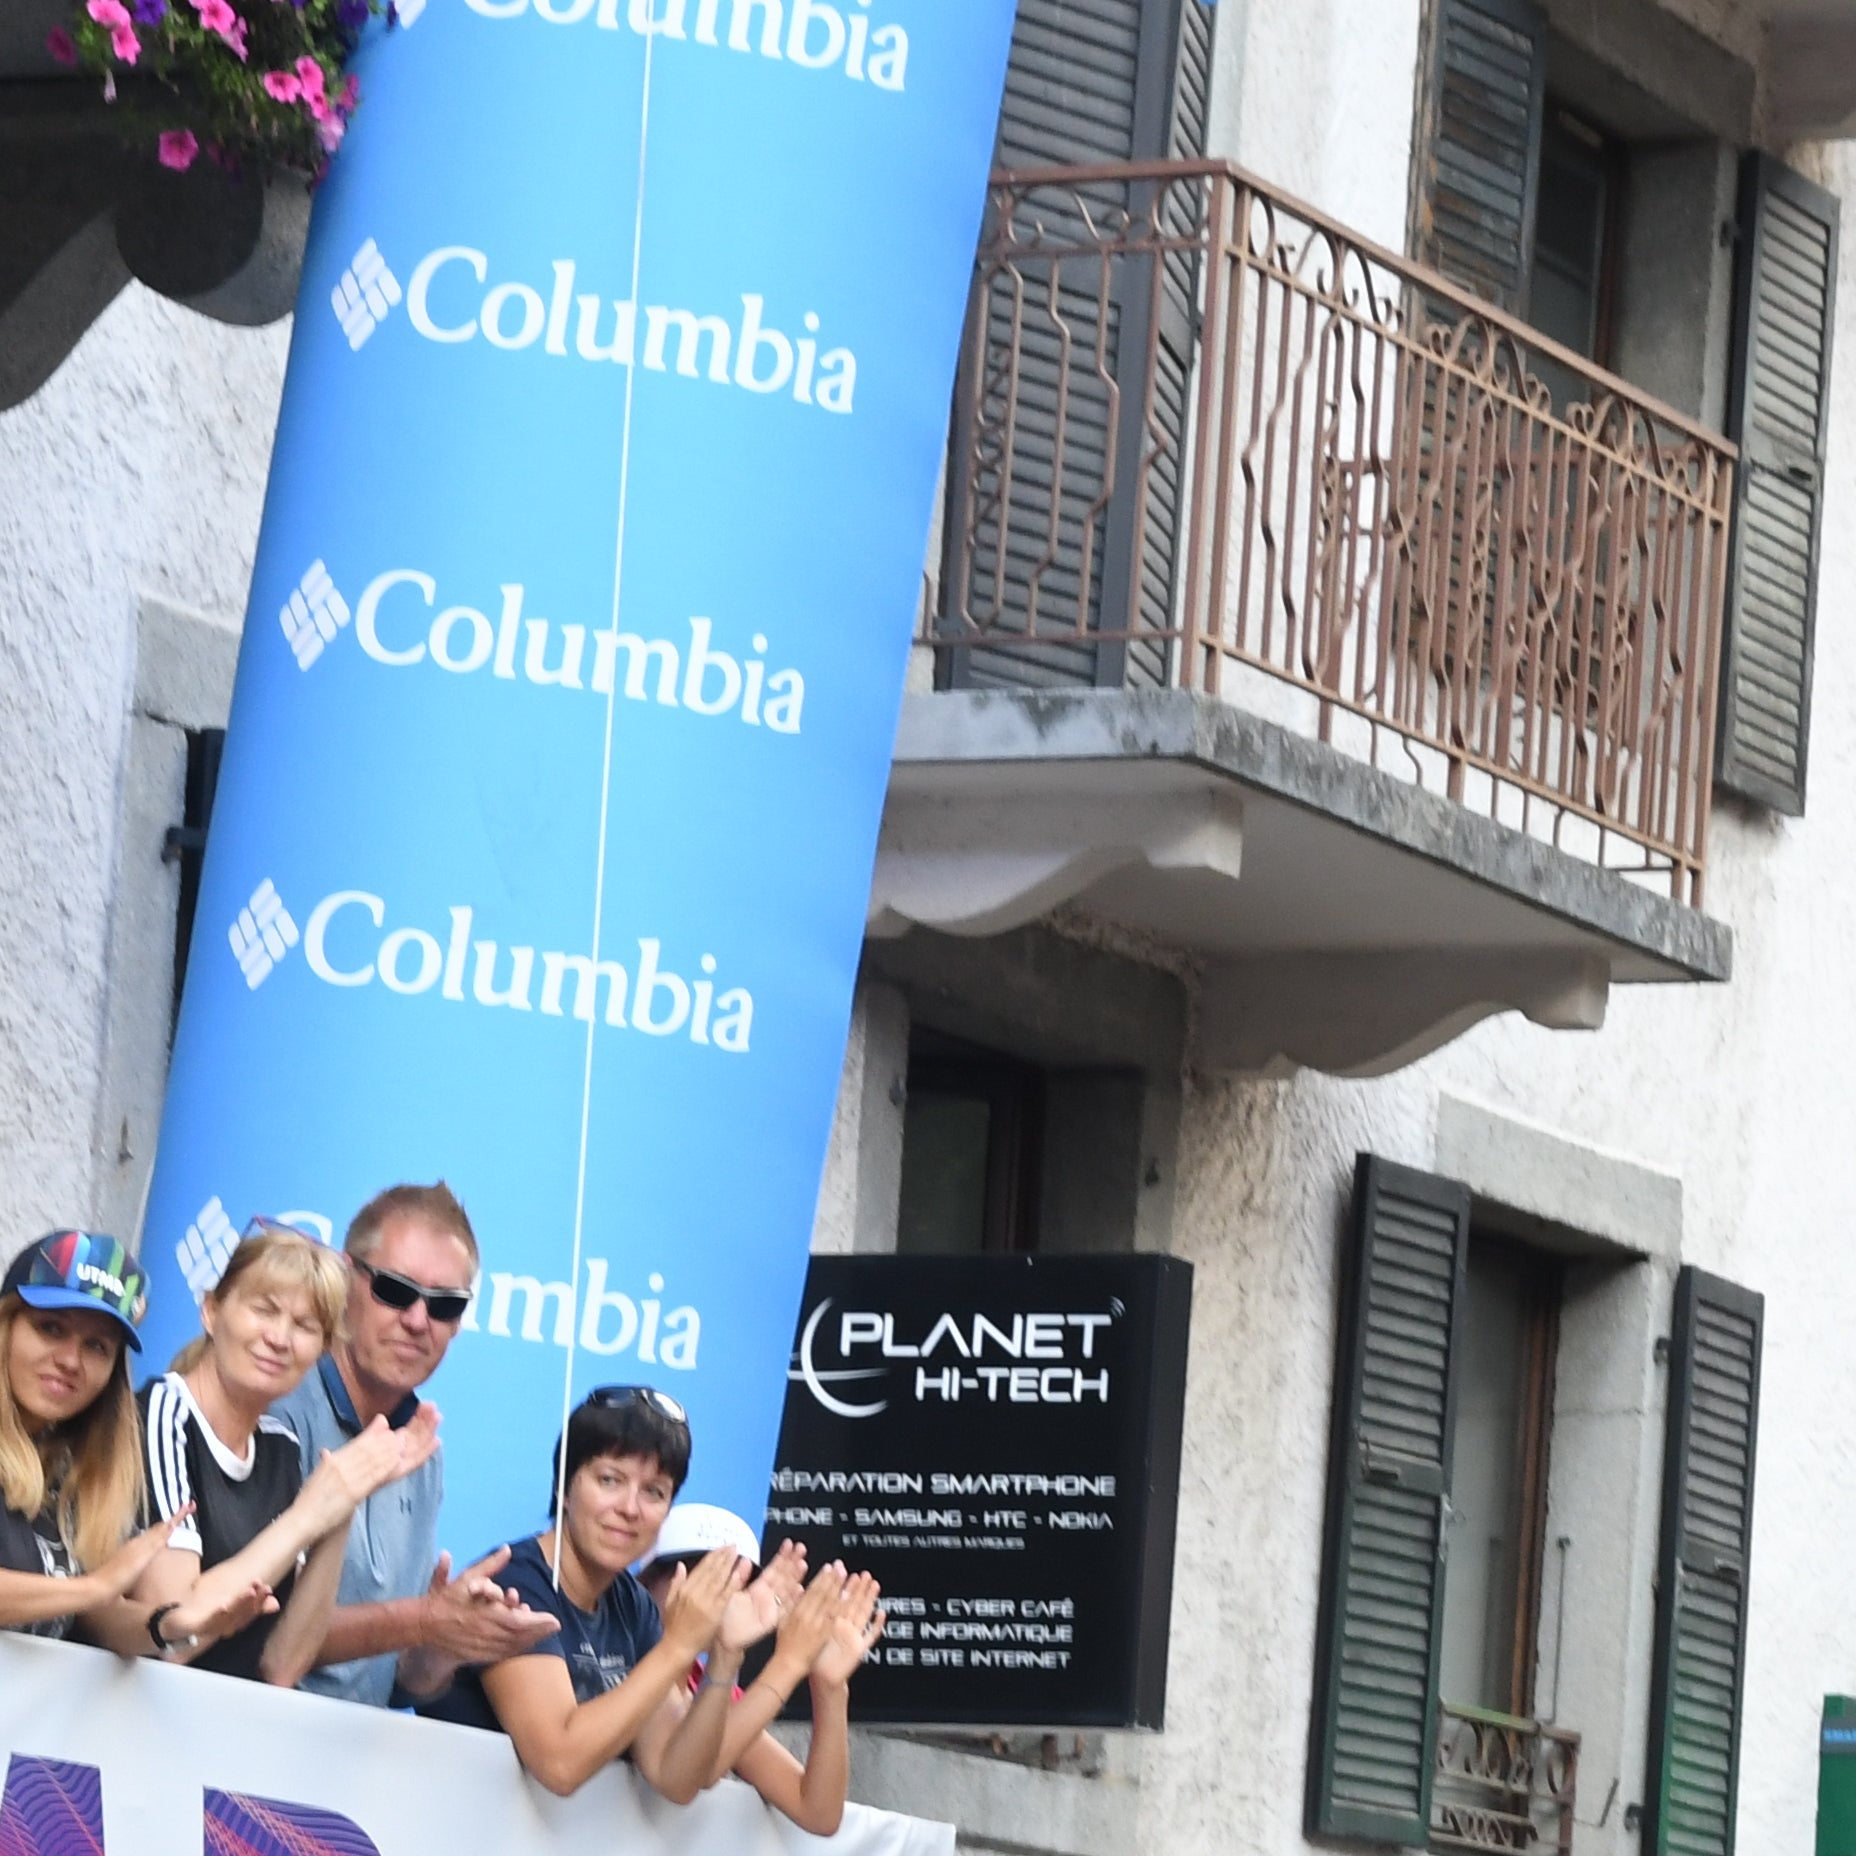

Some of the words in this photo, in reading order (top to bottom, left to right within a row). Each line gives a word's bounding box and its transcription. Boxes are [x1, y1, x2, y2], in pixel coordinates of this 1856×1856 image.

[406, 245, 857, 413] Columbia
[355, 569, 805, 735] Columbia
[304, 889, 755, 1052] Columbia
[840, 1312, 1112, 1359] PLANET
[914, 1366, 1110, 1403] HI-TECH
[930, 1472, 1117, 1498] SMARTPHONE
[854, 1508, 963, 1529] SAMSUNG
[983, 1509, 1028, 1530] HTC
[1048, 1511, 1114, 1531] NOKIA
[946, 1598, 1016, 1618] CYBER
[1020, 1595, 1075, 1618] CAFÉ
[919, 1621, 1074, 1643] INFORMATIQUE
[886, 1648, 914, 1666] DE
[920, 1649, 965, 1667] SITE
[969, 1649, 1072, 1670] INTERNET
